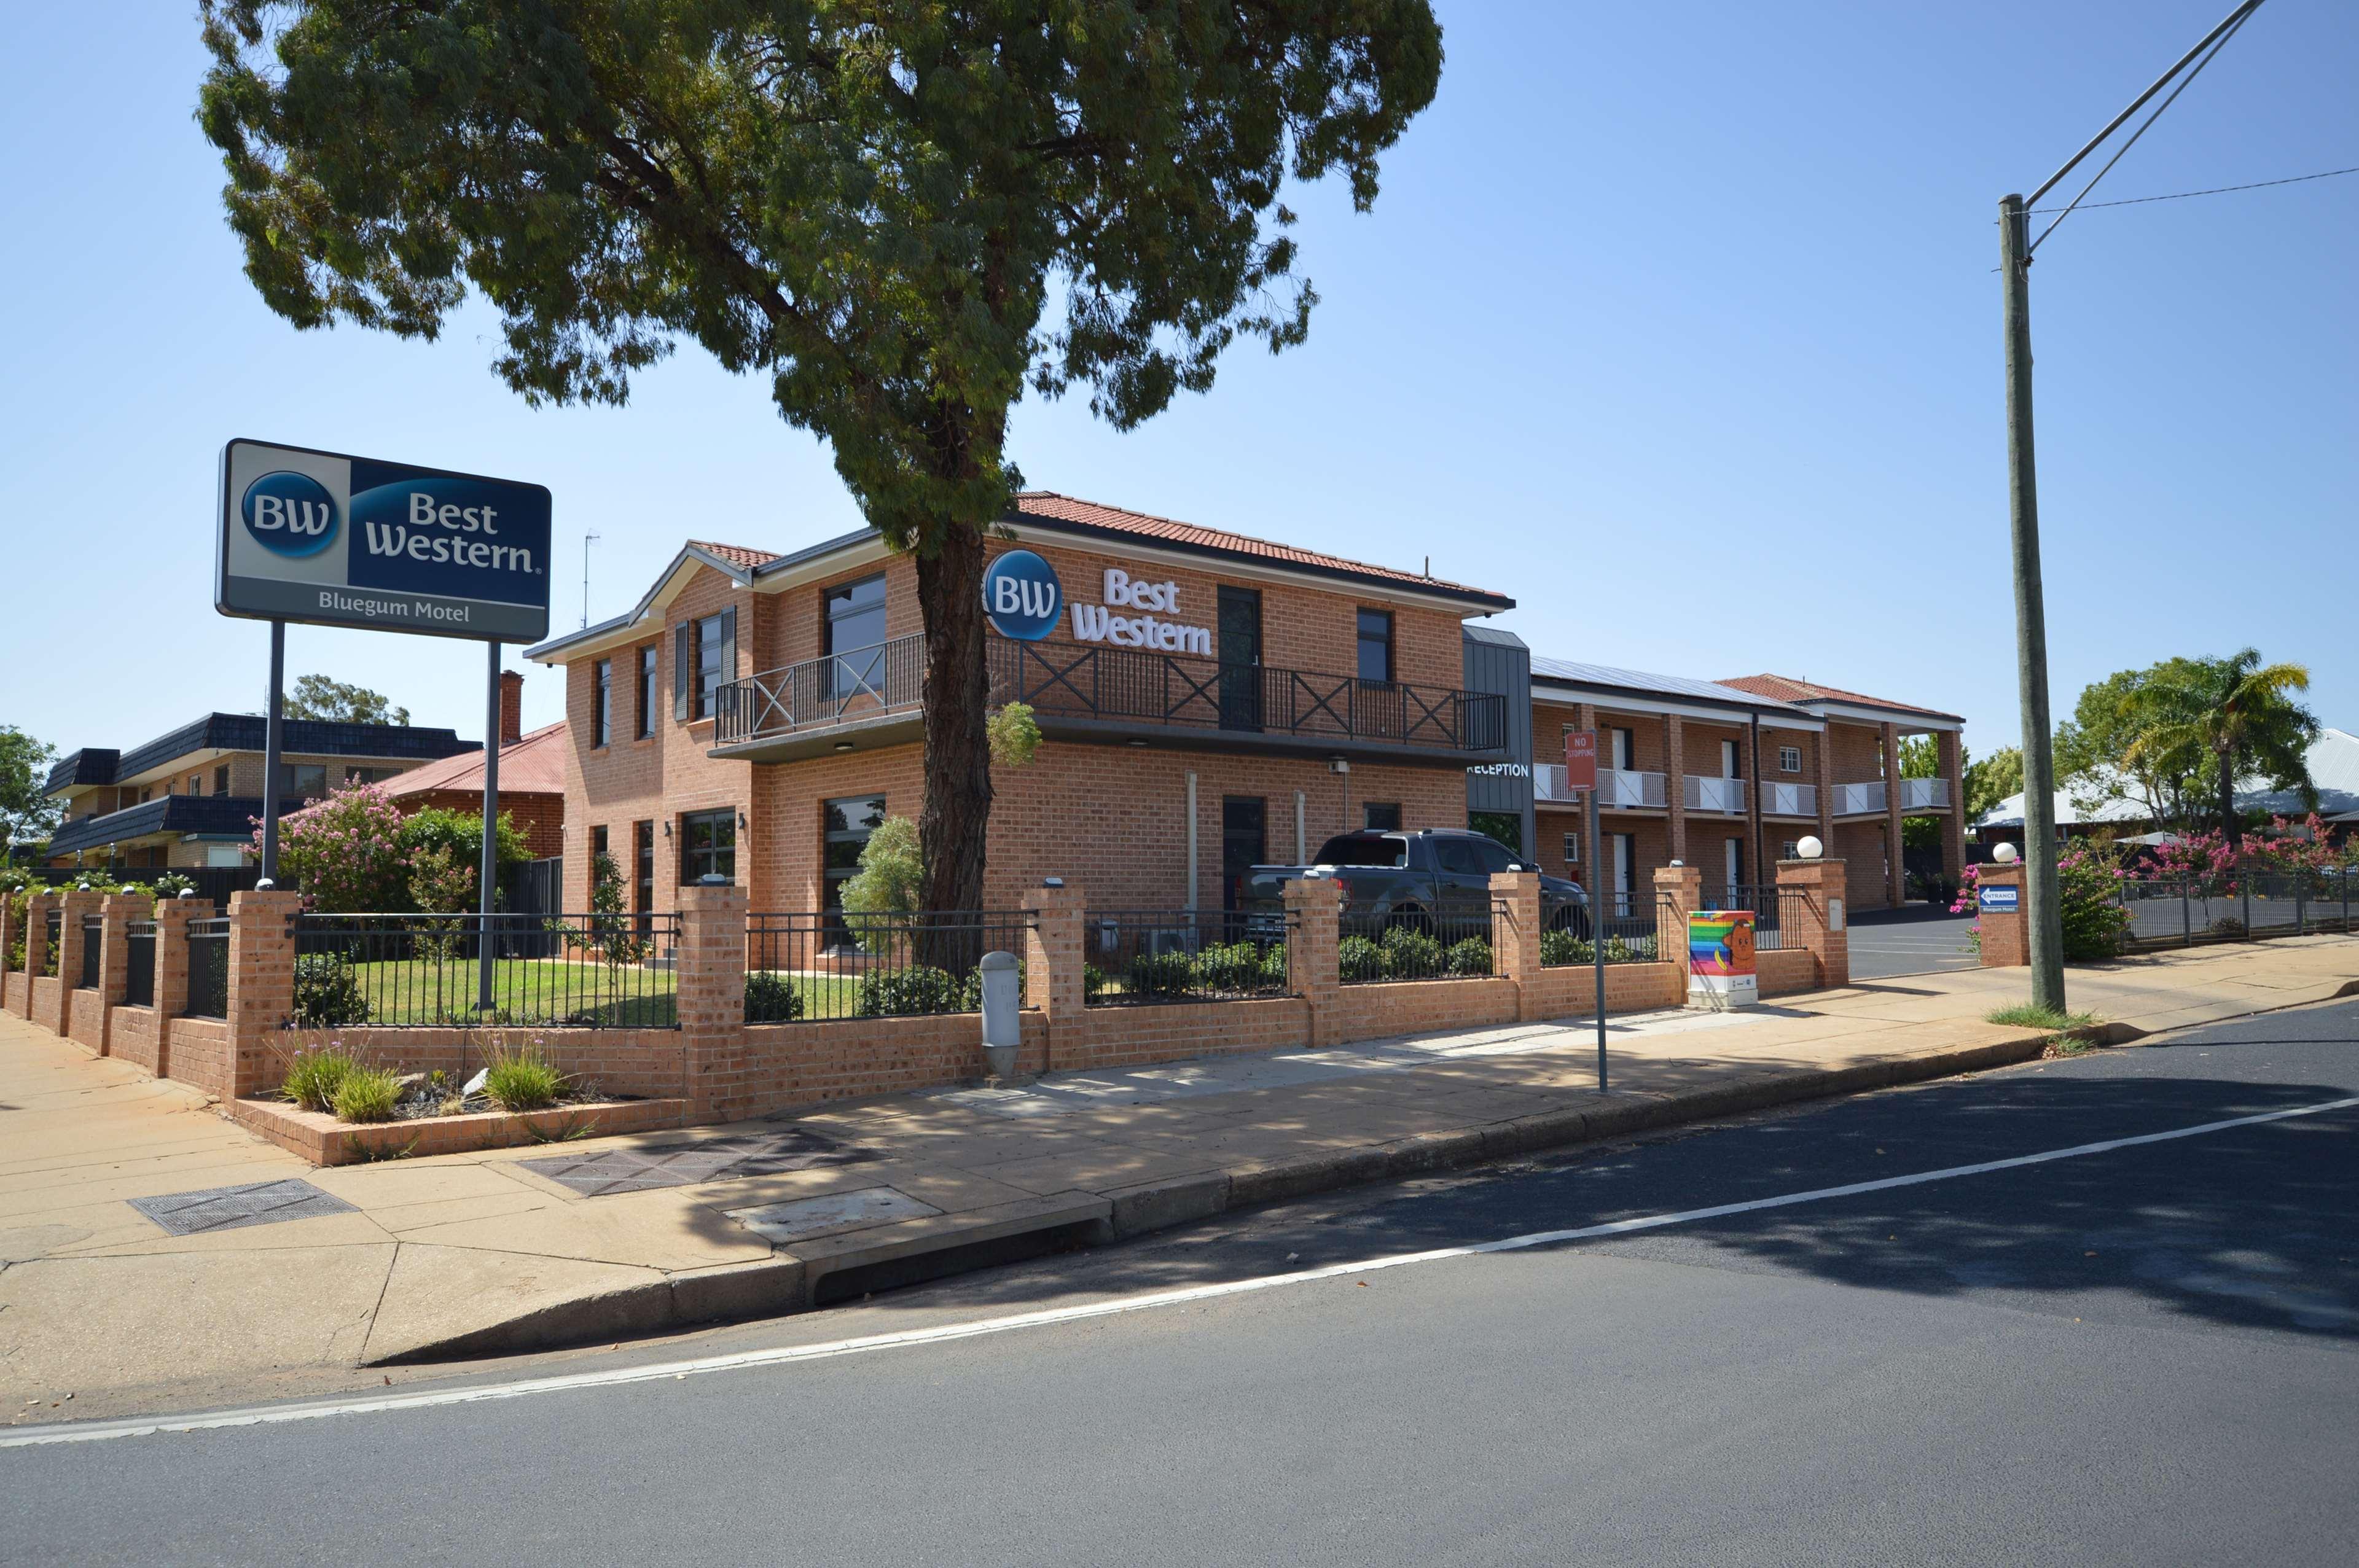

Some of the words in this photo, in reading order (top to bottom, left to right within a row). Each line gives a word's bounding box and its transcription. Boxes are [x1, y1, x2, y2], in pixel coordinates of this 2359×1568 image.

[254, 495, 329, 535] BW
[410, 493, 498, 535] Best
[319, 591, 408, 617] Bluegum
[415, 601, 470, 622] Motel
[995, 575, 1055, 618] BW
[1103, 569, 1180, 614] Best
[1070, 603, 1212, 656] Western
[1568, 749, 1594, 758] STOPPING
[1575, 738, 1586, 747] NO
